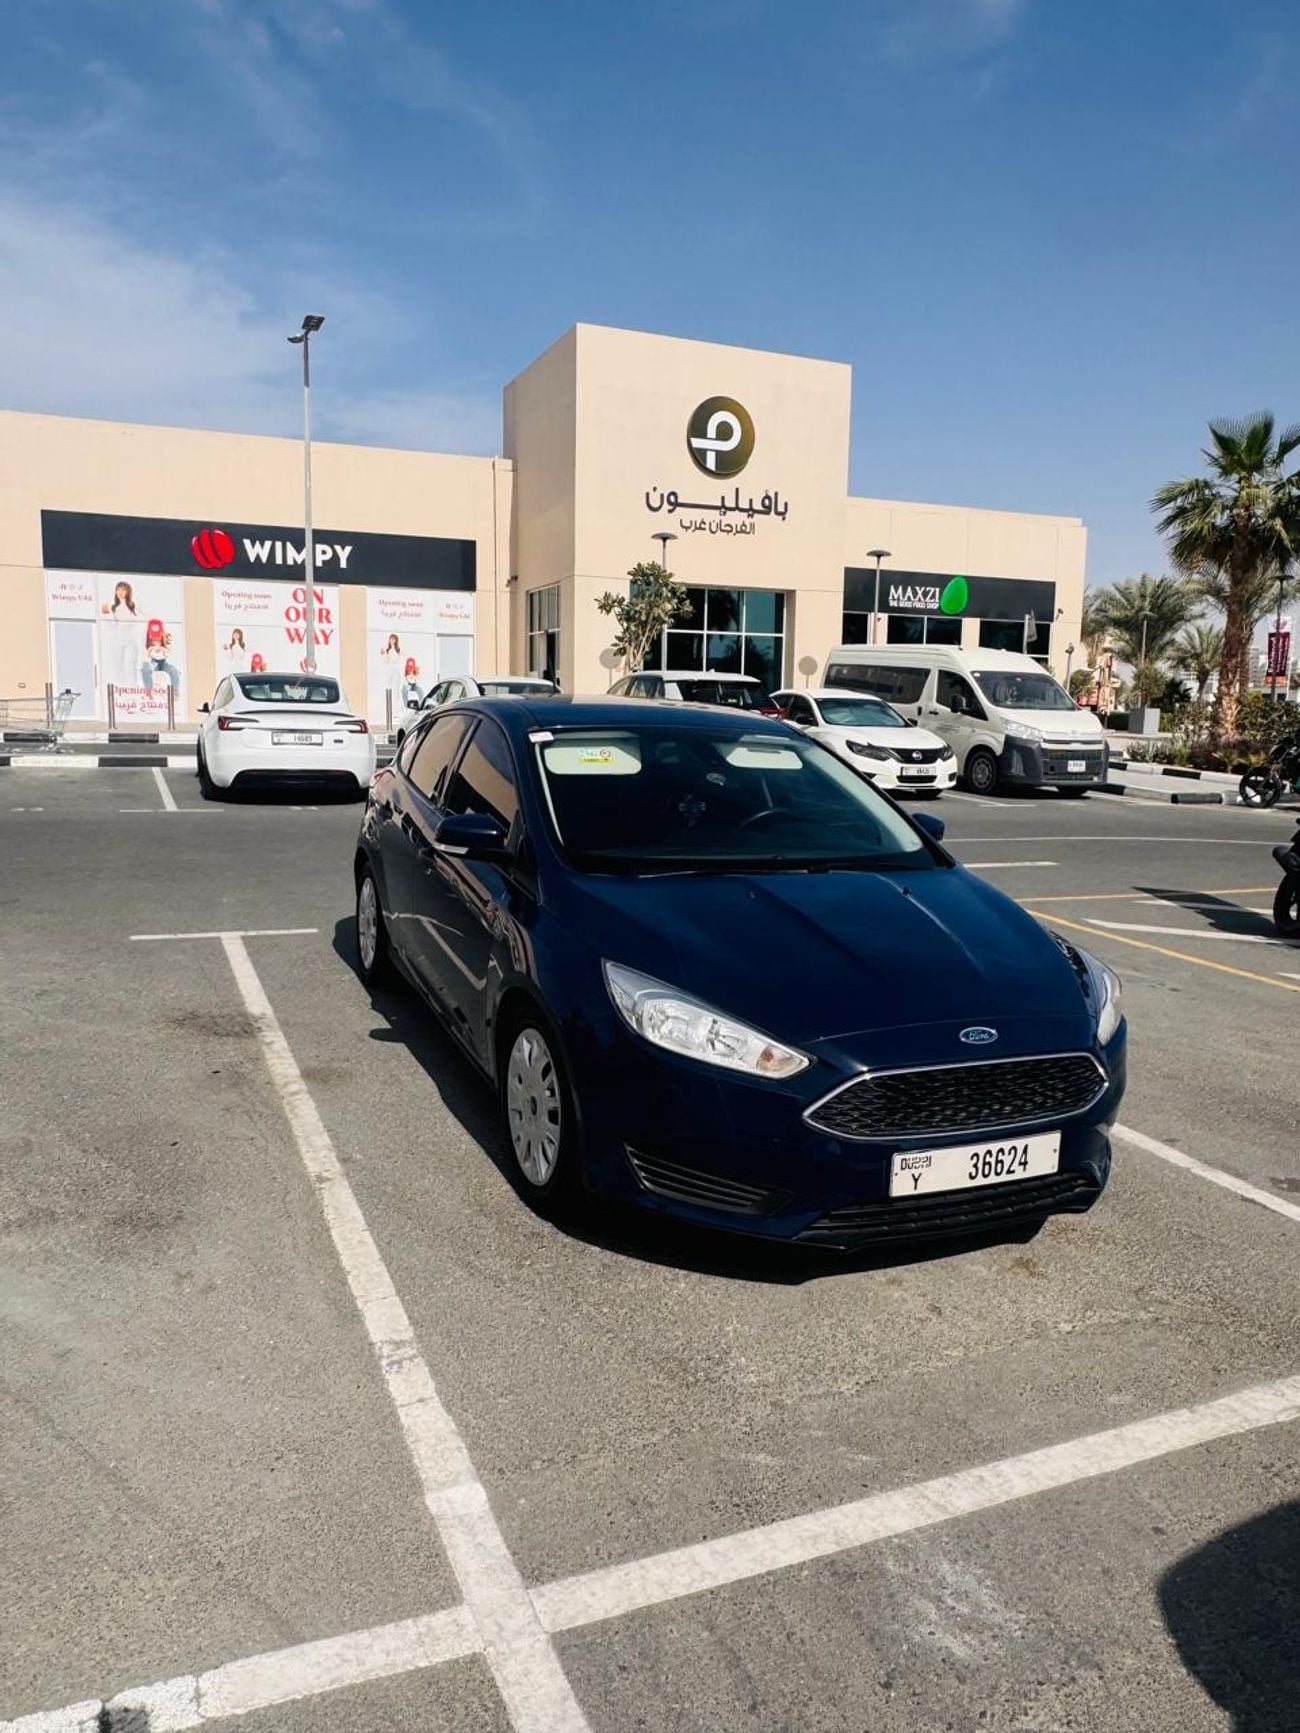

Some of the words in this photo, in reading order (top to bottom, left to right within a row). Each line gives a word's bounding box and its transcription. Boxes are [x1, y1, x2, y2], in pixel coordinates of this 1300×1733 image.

[680, 518, 707, 532] غرب
[708, 518, 755, 536] الفرجان
[242, 538, 353, 569] WIMPY
[292, 587, 324, 605] ON
[888, 584, 940, 603] MAXZI
[968, 1143, 1029, 1180] 36624
[911, 1172, 922, 1191] Y
